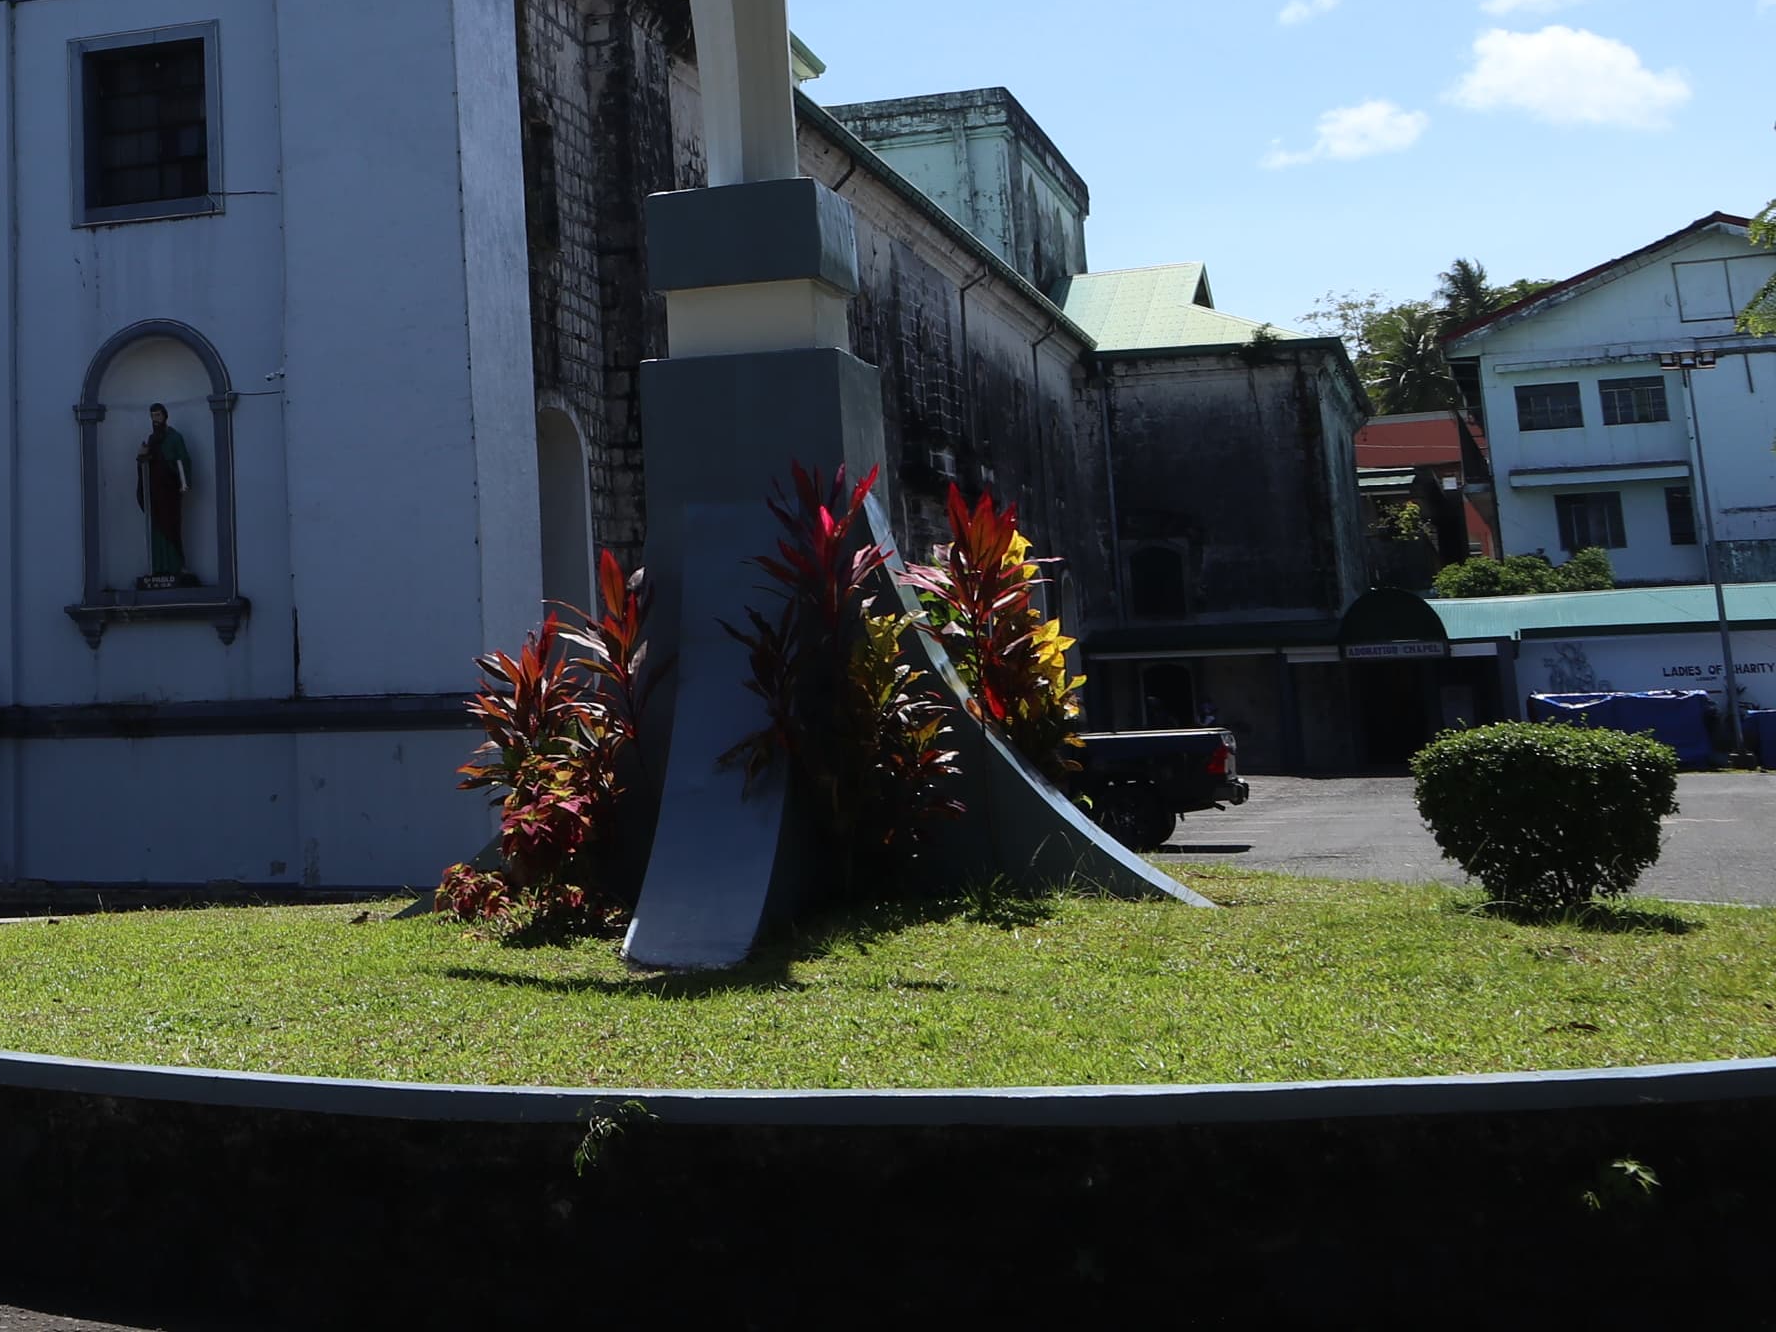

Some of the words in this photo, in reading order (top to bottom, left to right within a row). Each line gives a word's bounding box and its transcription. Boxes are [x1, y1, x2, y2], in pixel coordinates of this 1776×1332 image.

[1404, 643, 1441, 654] CHAPEL
[1662, 666, 1702, 677] LADIES
[1708, 664, 1723, 675] OF
[1733, 662, 1775, 674] HARITY
